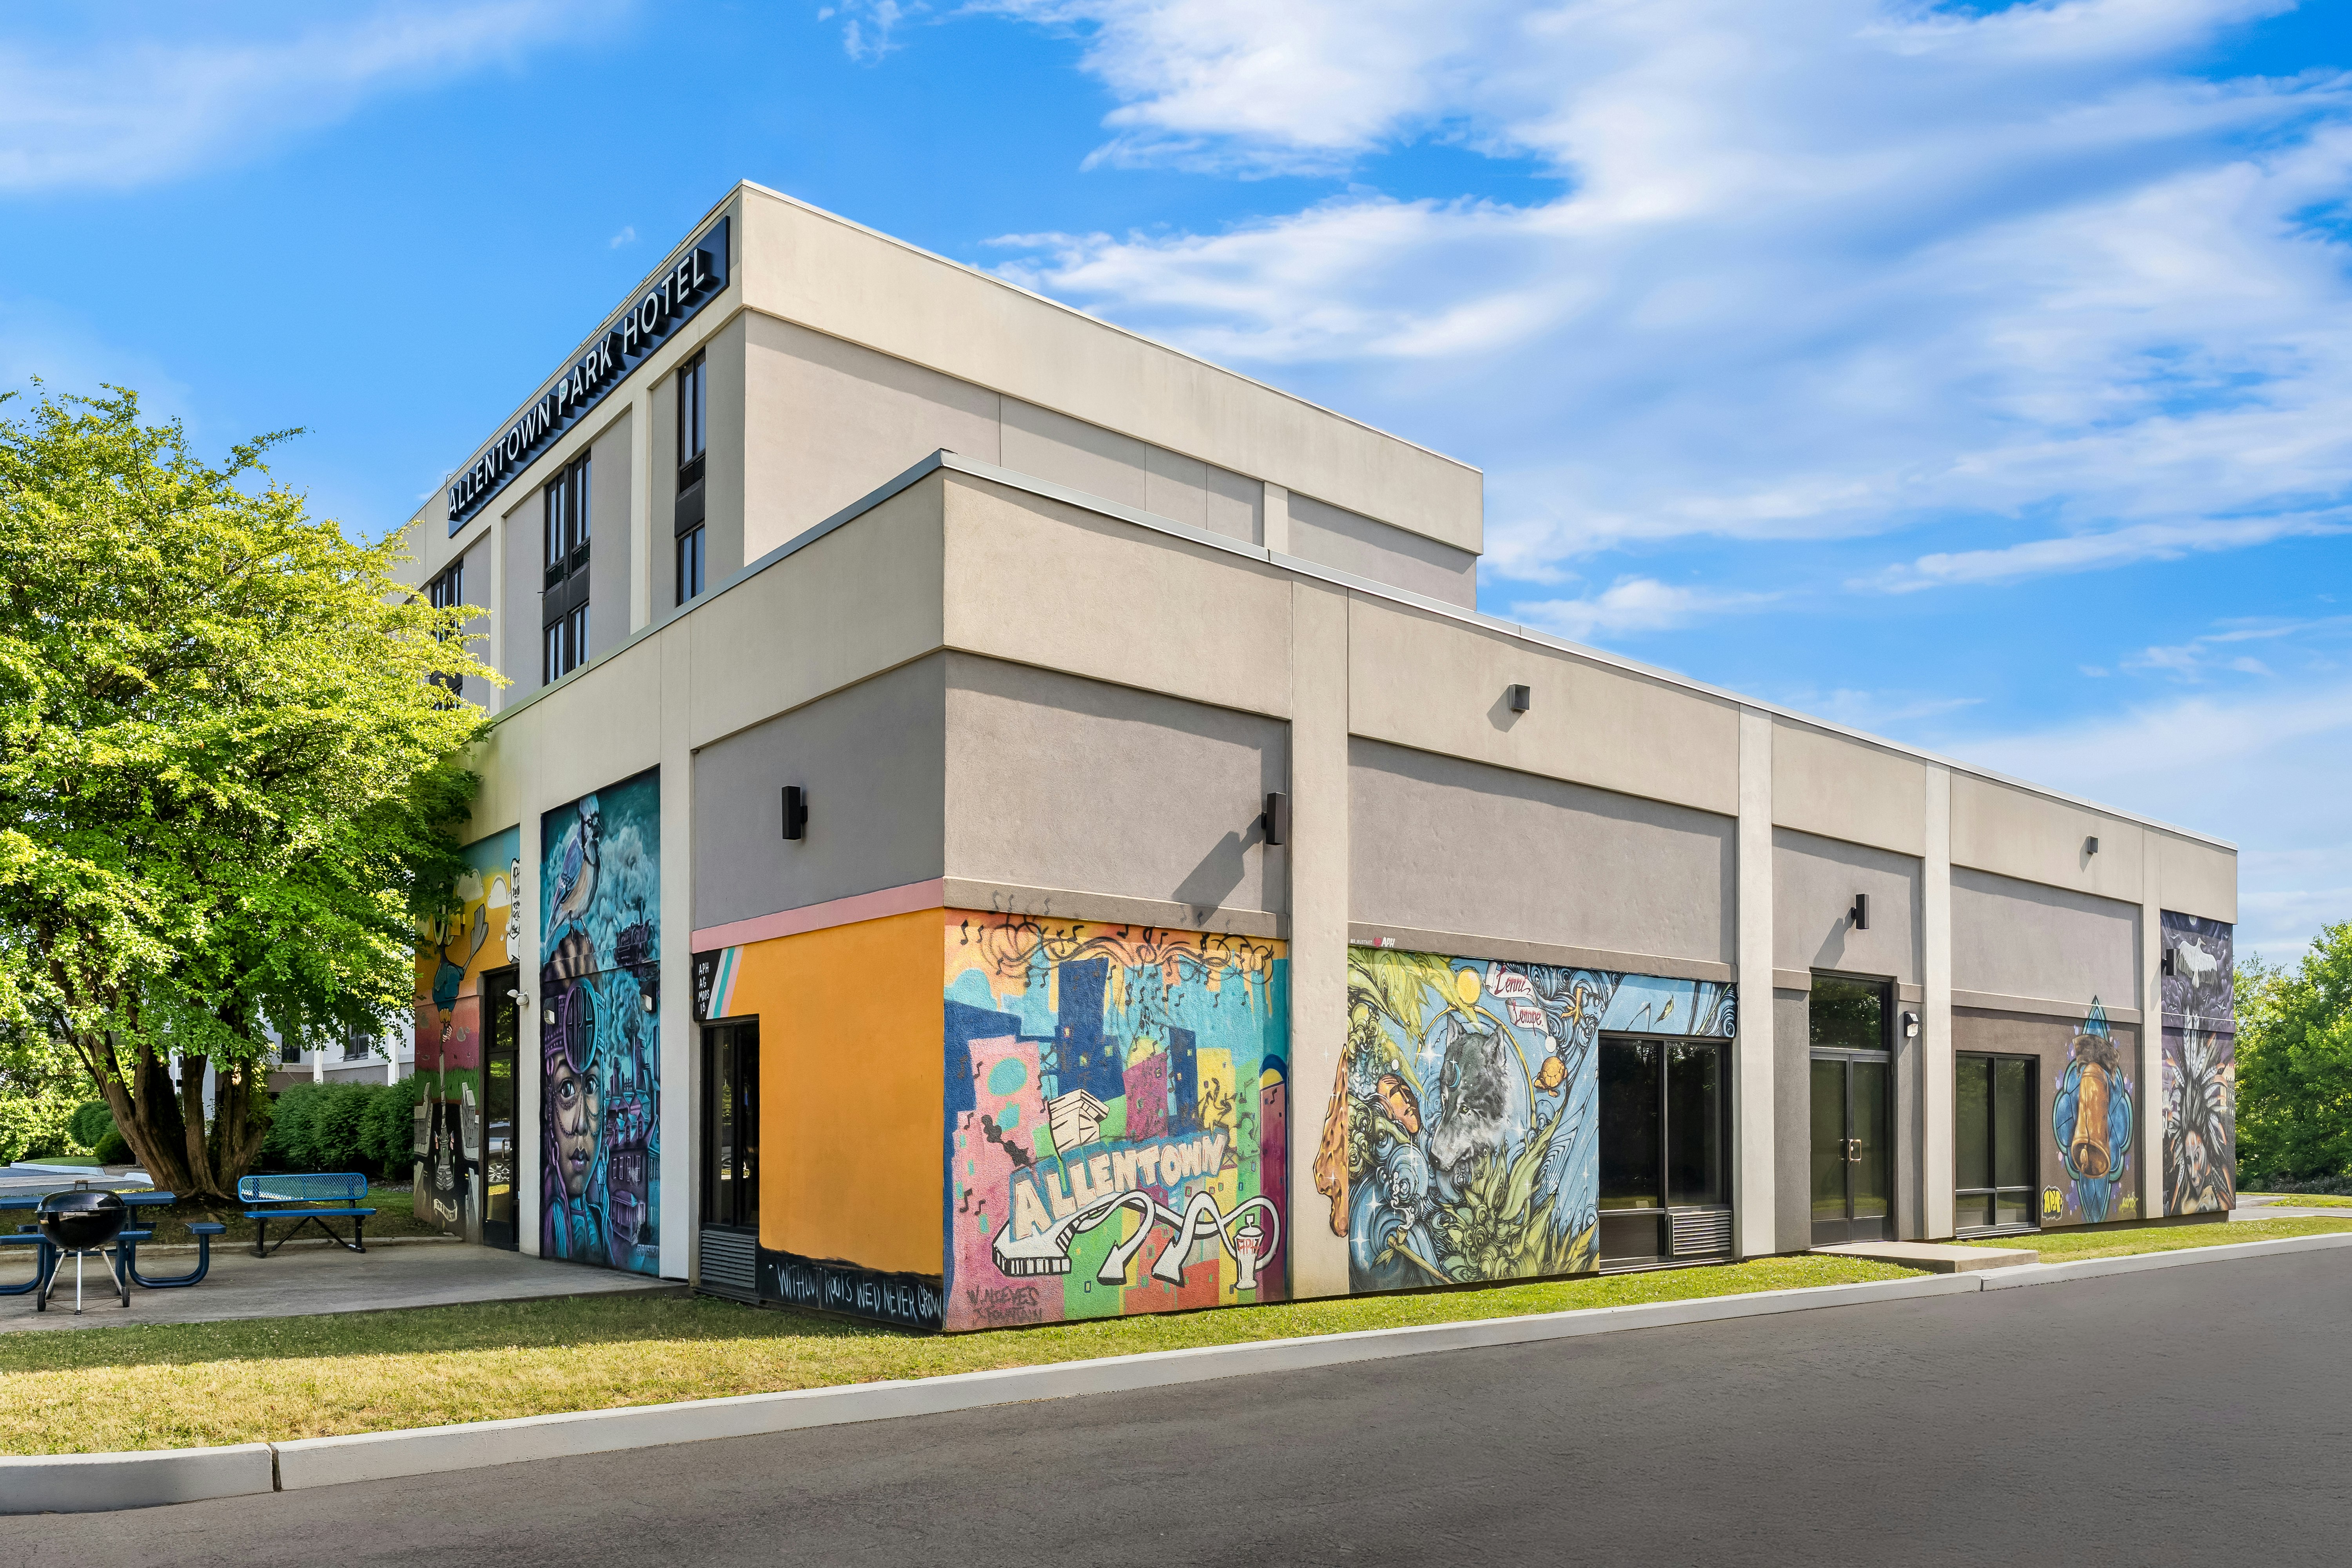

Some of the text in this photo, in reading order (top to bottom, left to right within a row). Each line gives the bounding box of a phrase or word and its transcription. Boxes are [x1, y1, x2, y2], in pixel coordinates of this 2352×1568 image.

[448, 248, 704, 520] ALLENTOWN PARK HOTEL
[1381, 936, 1396, 947] APH
[699, 962, 709, 976] APH
[699, 976, 706, 989] AG
[700, 1002, 706, 1014] 18
[1015, 1134, 1226, 1240] ALLENTOWN
[777, 1263, 822, 1301] WITHOUT
[824, 1270, 852, 1305] ROOTS
[883, 1279, 919, 1323] NEVER
[918, 1283, 942, 1319] GROW
